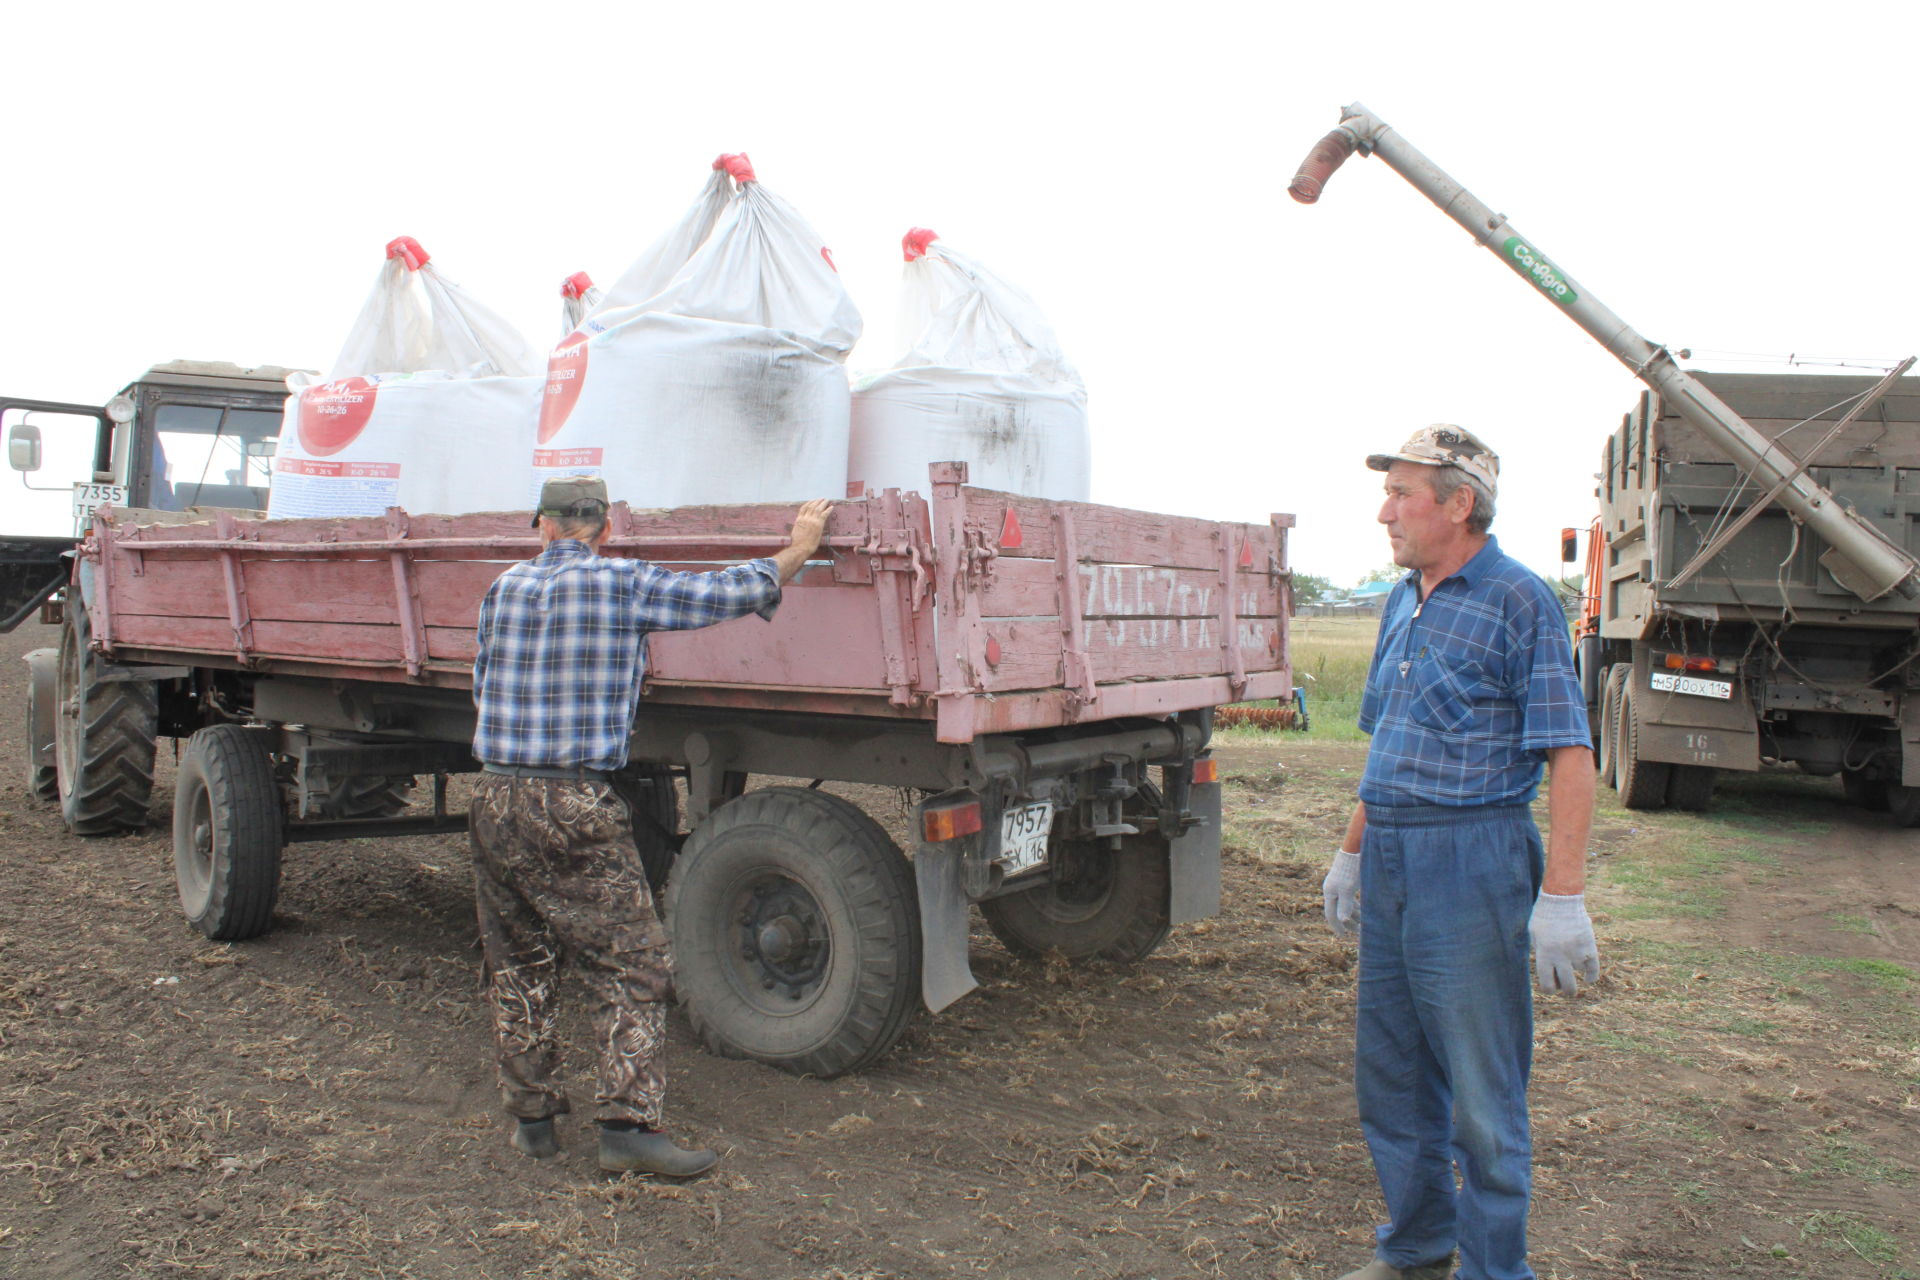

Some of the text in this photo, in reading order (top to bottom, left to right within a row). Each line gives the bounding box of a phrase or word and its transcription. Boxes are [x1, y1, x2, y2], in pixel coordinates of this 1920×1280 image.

[80, 484, 122, 501] 7355
[1686, 734, 1708, 749] 16
[1006, 805, 1047, 841] 7957
[1030, 841, 1045, 862] 16
